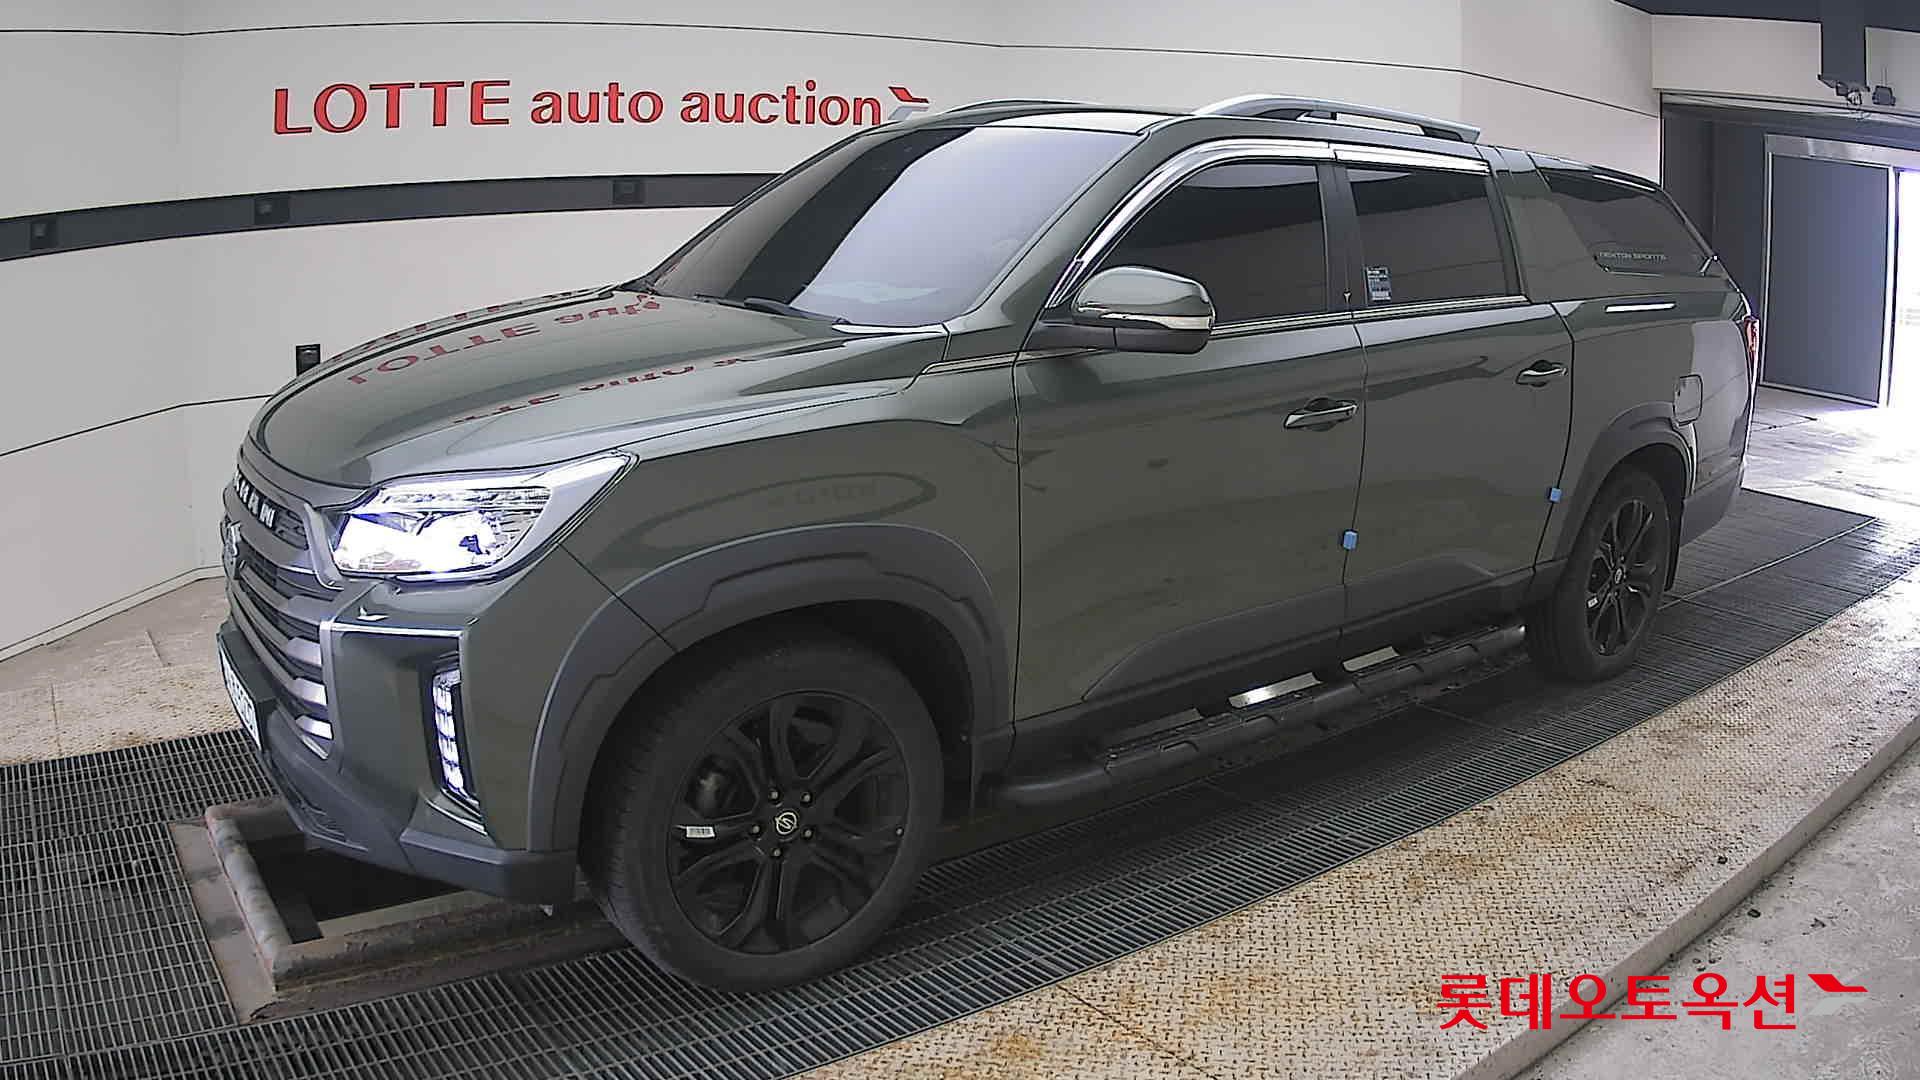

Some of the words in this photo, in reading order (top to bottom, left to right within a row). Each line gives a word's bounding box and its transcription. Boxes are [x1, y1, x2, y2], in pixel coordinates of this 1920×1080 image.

[274, 80, 511, 135] LOTTE
[530, 81, 665, 125] auto
[680, 79, 883, 127] auction
